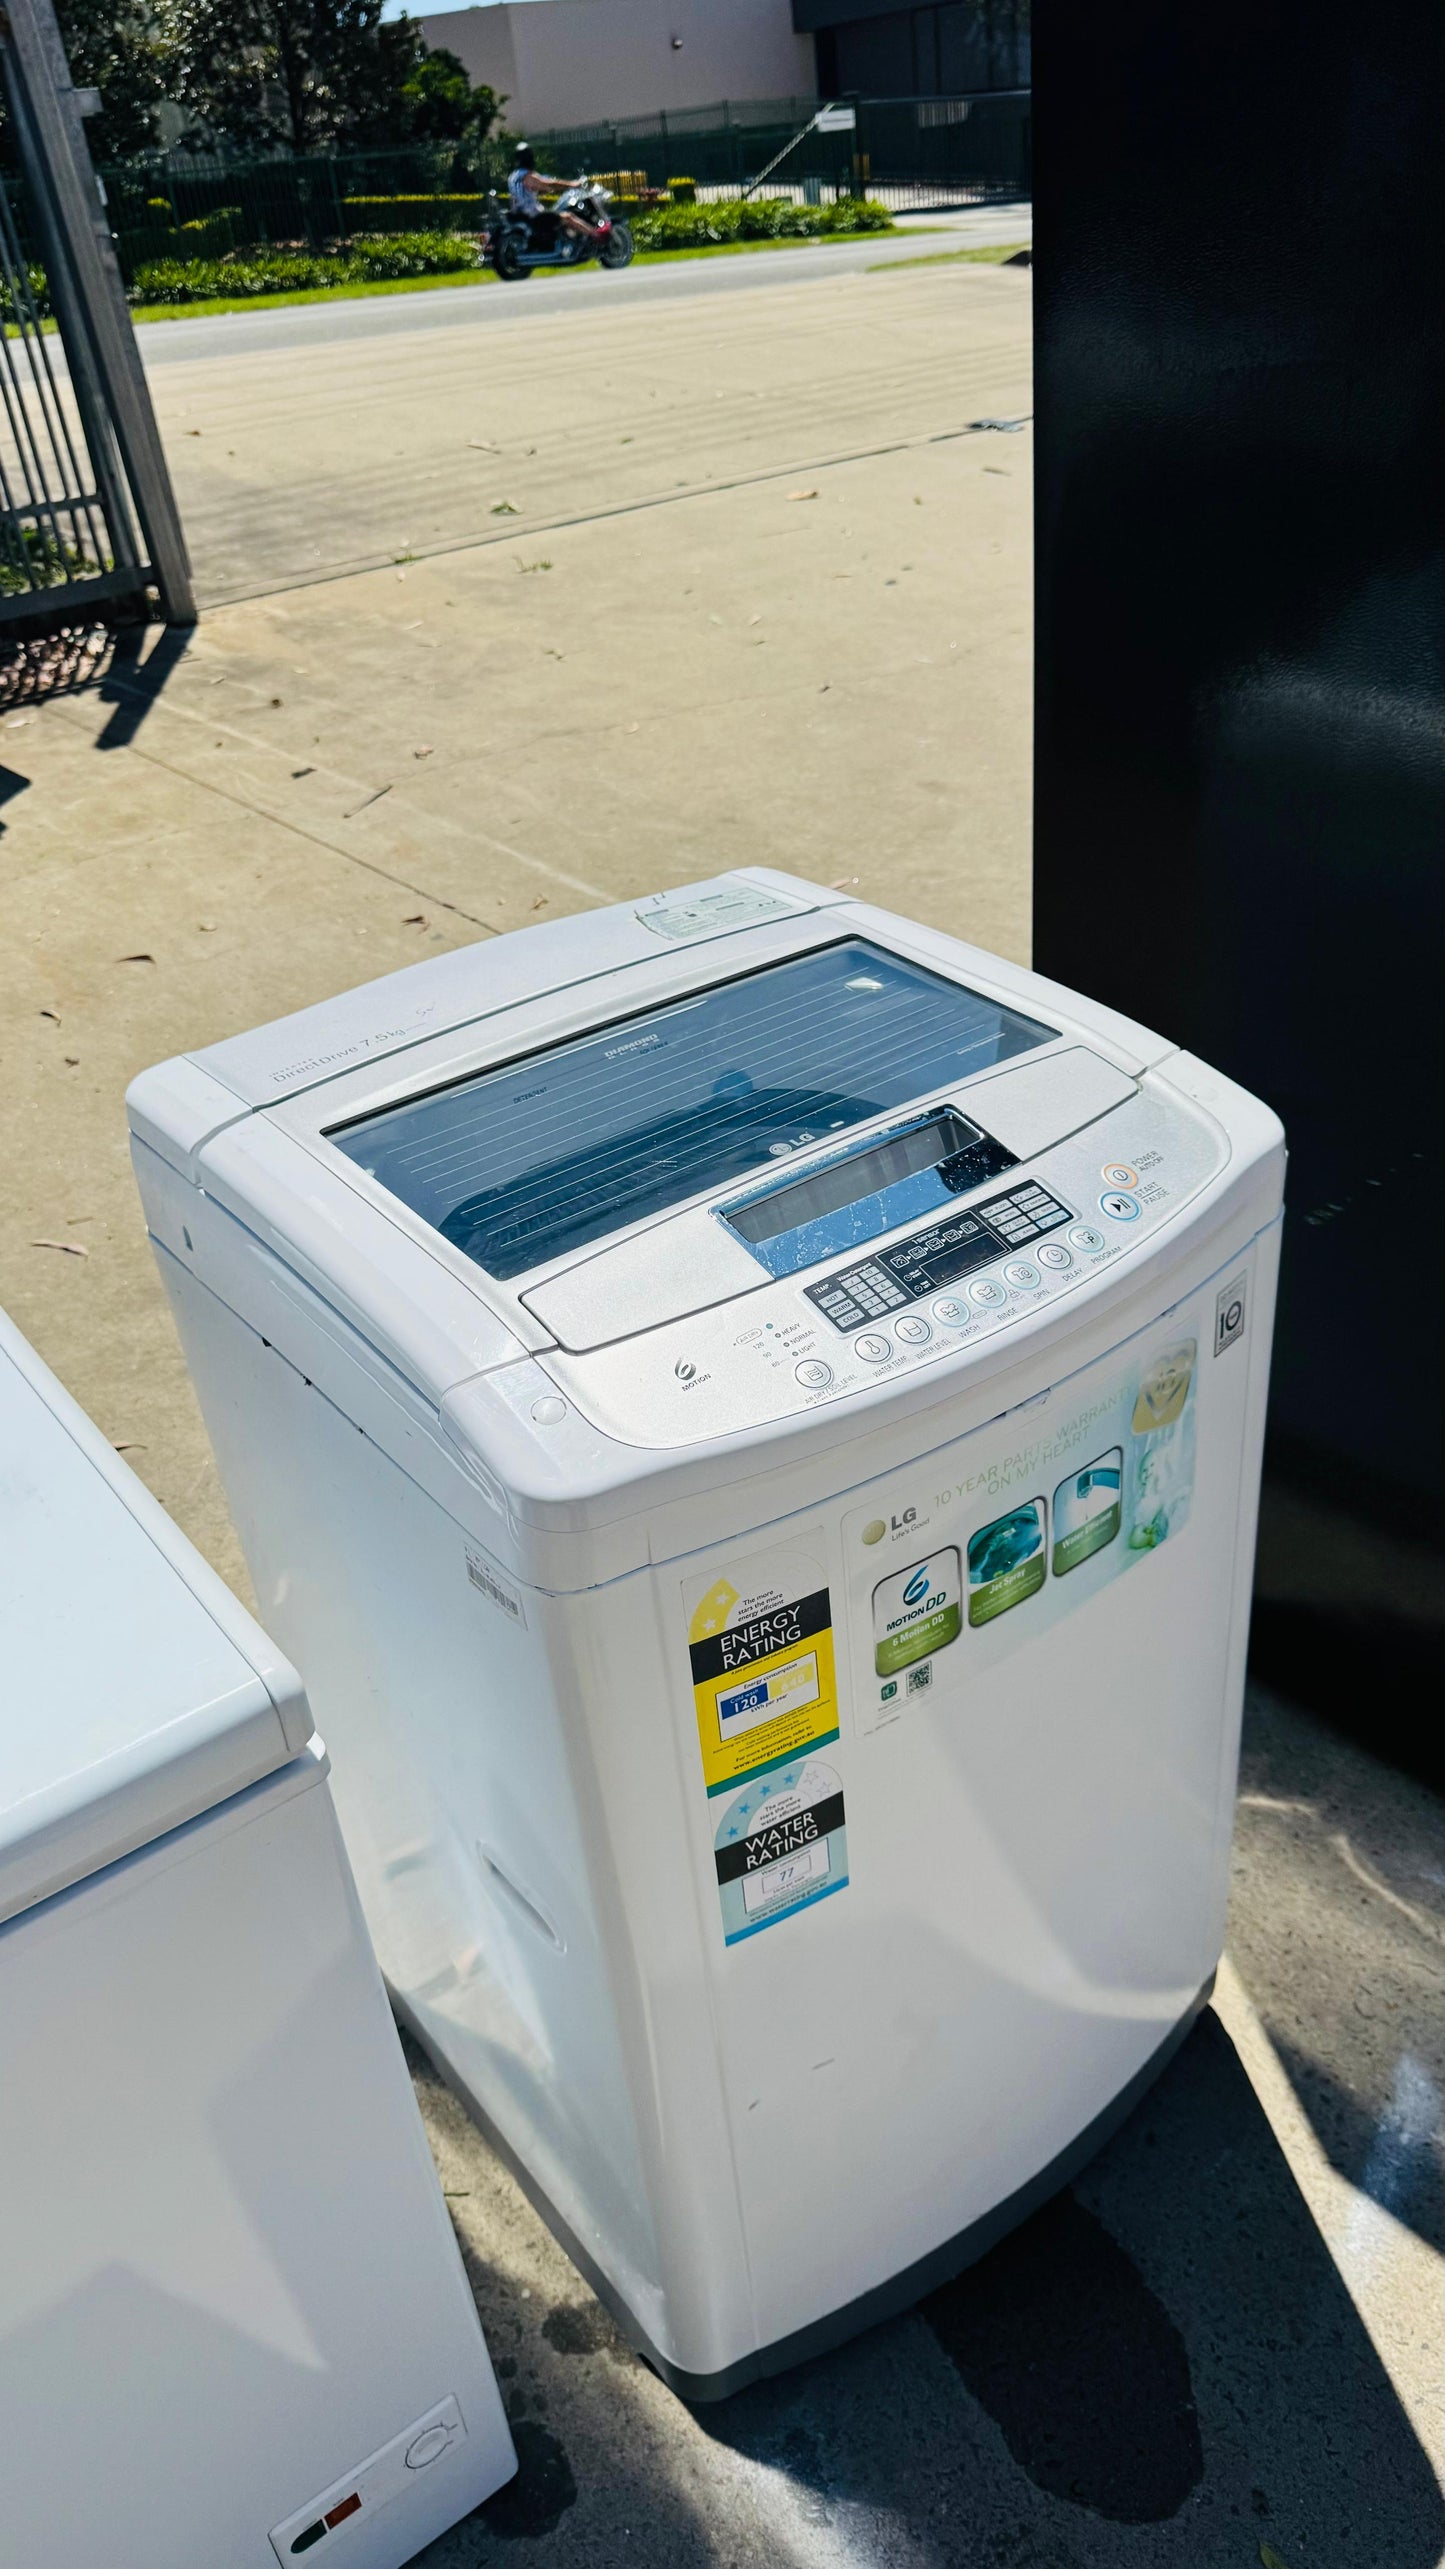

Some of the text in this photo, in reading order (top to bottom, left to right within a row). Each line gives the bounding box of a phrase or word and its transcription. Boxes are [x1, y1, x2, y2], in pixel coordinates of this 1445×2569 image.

[604, 1033, 658, 1058] DIAMOND
[789, 1131, 816, 1147] LG
[1131, 1151, 1158, 1166] POWER
[1134, 1182, 1159, 1197] START
[1143, 1188, 1170, 1205] PAUSE
[1090, 1245, 1122, 1265] PROGRAM
[1061, 1267, 1084, 1282] DELAY
[826, 1294, 839, 1303] HOT
[1032, 1288, 1050, 1300] SPIN
[832, 1302, 852, 1314] WARM
[997, 1307, 1018, 1321] RINSE
[842, 1312, 860, 1323] COLD
[781, 1322, 801, 1336] HEAVY
[789, 1328, 817, 1346] NORMAL
[958, 1324, 981, 1338] WASH
[798, 1341, 817, 1355] LIGHT
[915, 1338, 951, 1360] WATER LEVEL
[873, 1365, 893, 1378] WATER
[681, 1373, 712, 1392] MOTION
[987, 1427, 1090, 1495] ON MY HEART
[934, 1490, 952, 1508] 10
[956, 1465, 998, 1497] YEAR
[891, 1507, 917, 1531] LG
[891, 1516, 930, 1542] Life's Good
[738, 1593, 784, 1616] stars the more
[743, 1590, 774, 1606] The more
[737, 1599, 785, 1623] energy efficient
[886, 1606, 925, 1632] MOTION
[925, 1591, 947, 1612] DD
[720, 1605, 801, 1653] ENERGY
[892, 1613, 945, 1647] 6 Motion DD
[723, 1624, 801, 1670] RATING
[743, 1663, 798, 1690] Energy consumption
[730, 1688, 759, 1704] Cold wash
[734, 1695, 758, 1713] 120
[760, 1798, 801, 1821] stars the more
[765, 1796, 793, 1812] The more
[760, 1816, 778, 1827] water
[745, 1812, 815, 1853] WATER
[746, 1825, 819, 1870] RATING
[780, 1867, 794, 1882] 77
